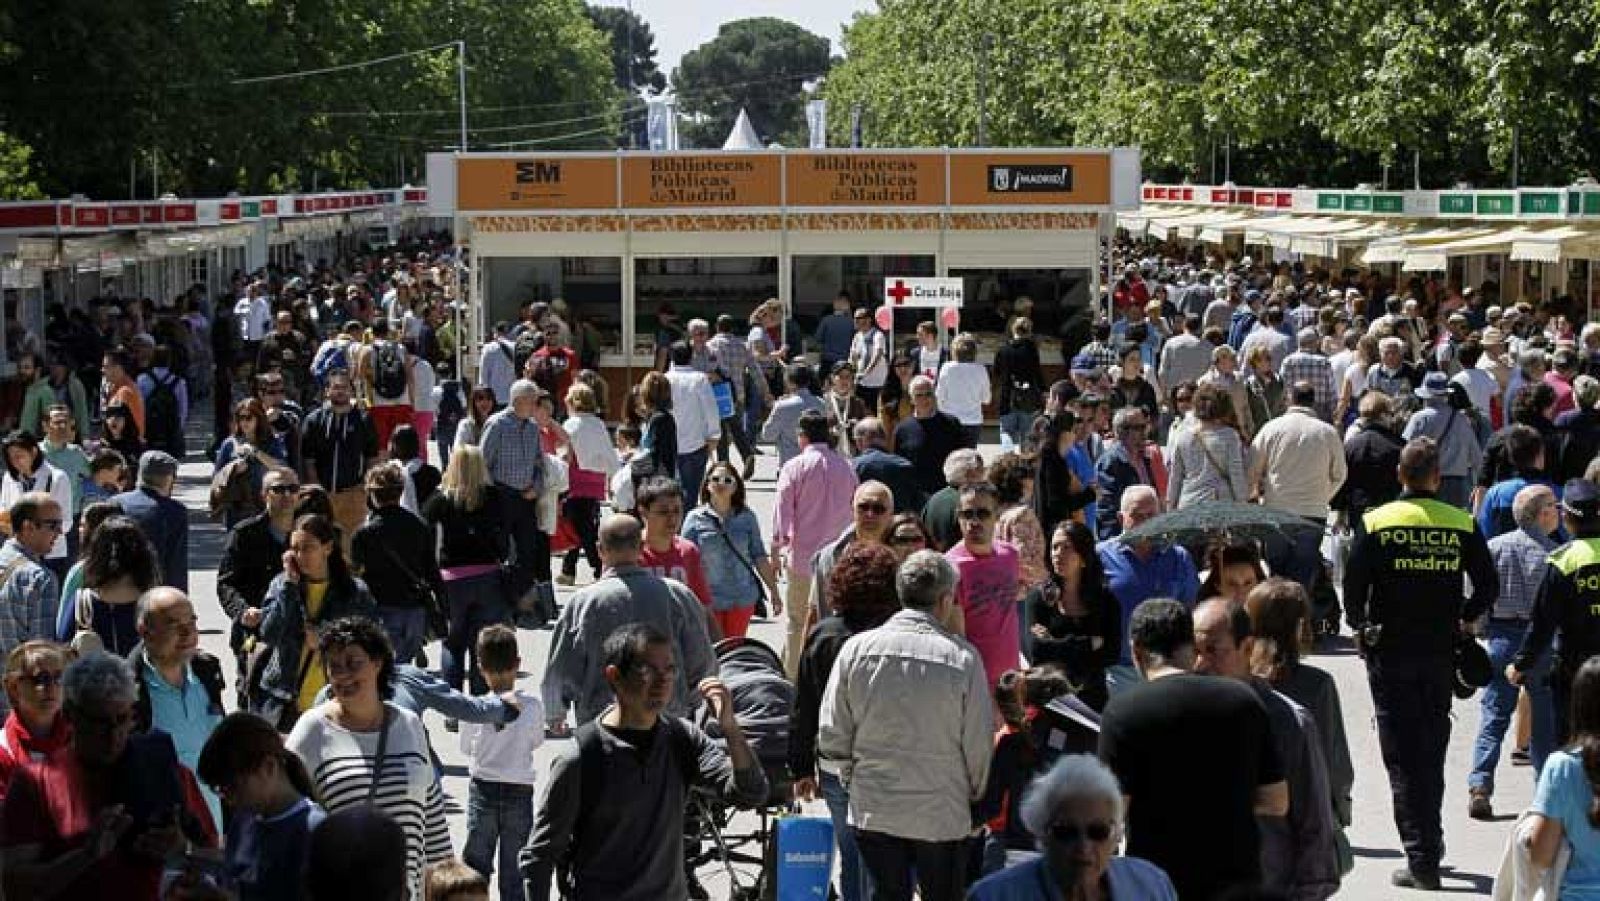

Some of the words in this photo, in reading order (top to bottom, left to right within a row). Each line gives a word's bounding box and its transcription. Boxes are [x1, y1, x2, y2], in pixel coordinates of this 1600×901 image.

[651, 156, 754, 172] Bibliotecas
[813, 155, 917, 170] Bibliotecas
[914, 286, 937, 297] Cruz
[1380, 529, 1461, 547] POLICIA
[1395, 555, 1460, 571] madrid
